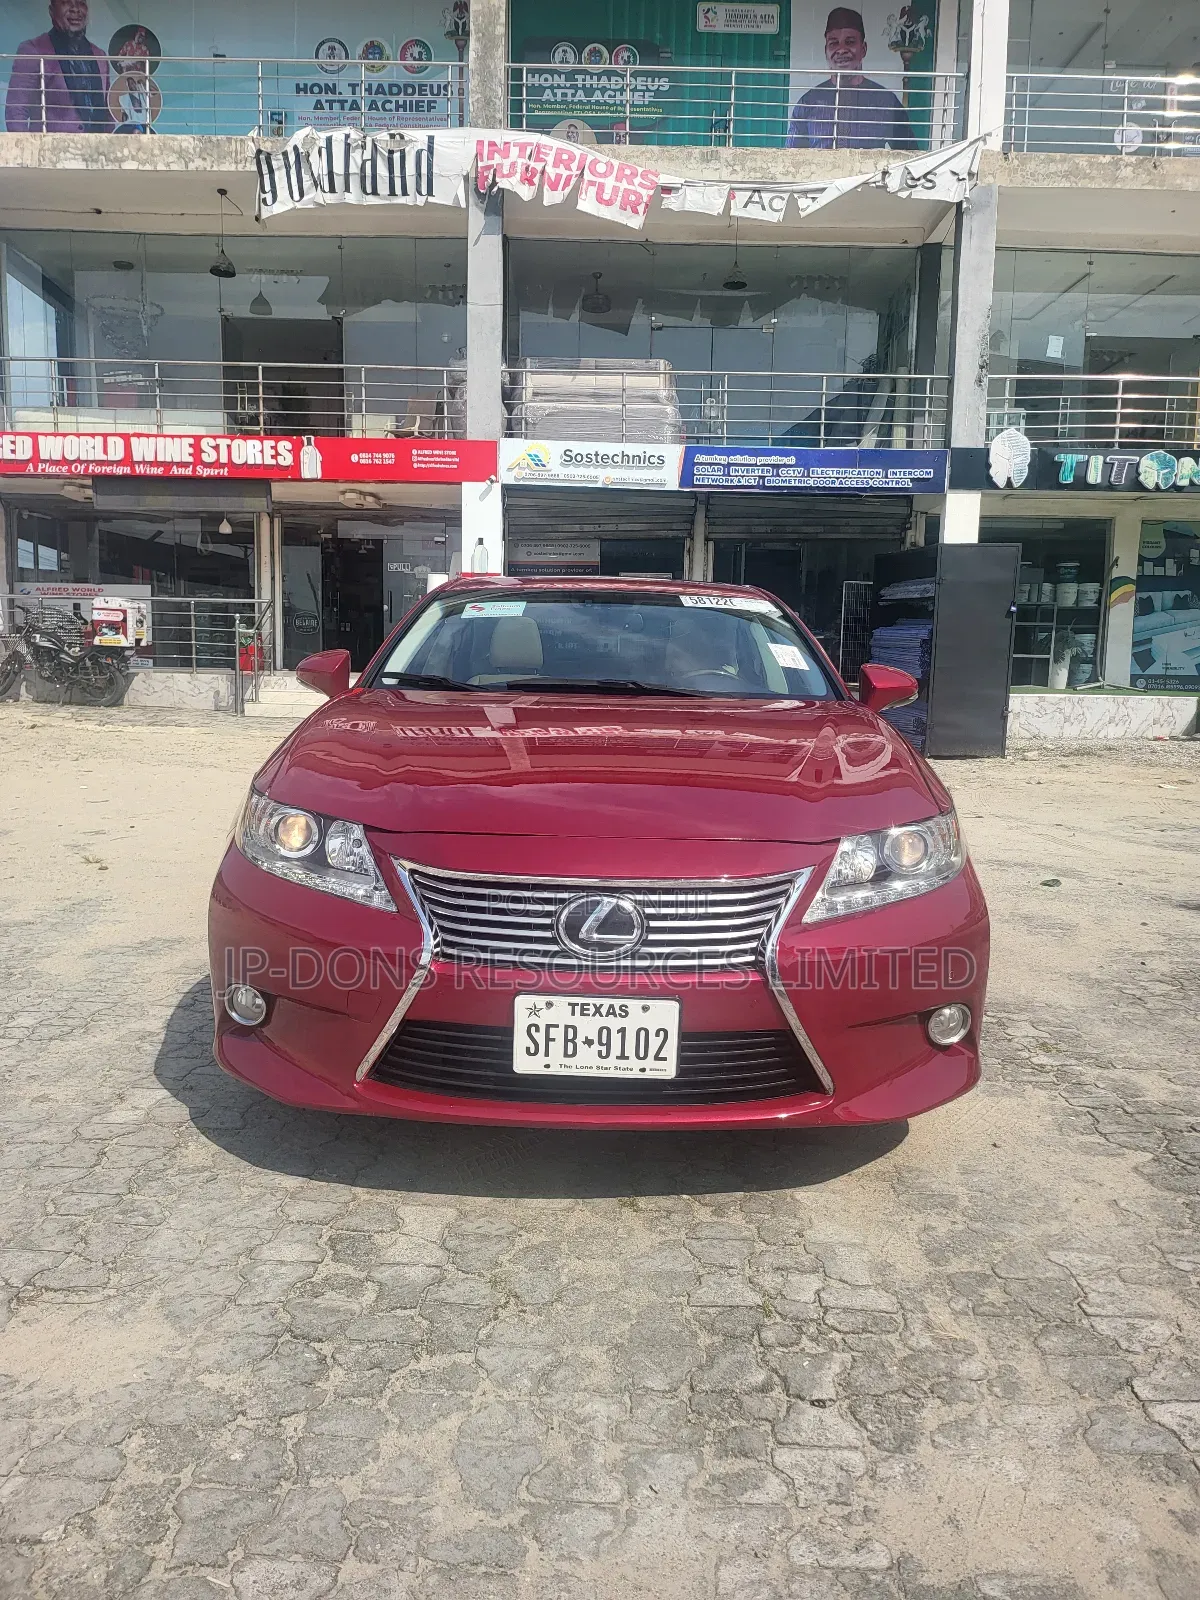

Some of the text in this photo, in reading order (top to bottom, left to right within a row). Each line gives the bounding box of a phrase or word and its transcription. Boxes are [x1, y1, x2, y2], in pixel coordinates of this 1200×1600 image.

[527, 73, 670, 91] HON. THADDEUS
[296, 83, 453, 97] HON. THADDEUS
[542, 88, 655, 105] ATTA ACHIEF
[313, 99, 437, 113] ATTA ACHIEF
[476, 139, 660, 191] INTERIORS
[0, 434, 294, 467] ED WORLD WINE STORES
[562, 449, 665, 466] Sostechnics
[758, 456, 784, 465] provider
[26, 463, 35, 472] A
[37, 463, 70, 473] Place
[71, 463, 87, 473] Of
[88, 463, 131, 475] Foreign
[134, 465, 164, 474] Wine
[169, 465, 192, 475] And
[694, 466, 933, 478] SOLAR INVERTER CCTV ELECTRIFICATION INTERCOM
[694, 477, 735, 485] NETWORK
[743, 477, 758, 485] ICT
[765, 478, 811, 486] BIOMETRIC
[812, 478, 837, 486] DOOR
[838, 479, 871, 487] ACCESS
[871, 479, 911, 487] CONTROL
[567, 1002, 629, 1018] TEXAS
